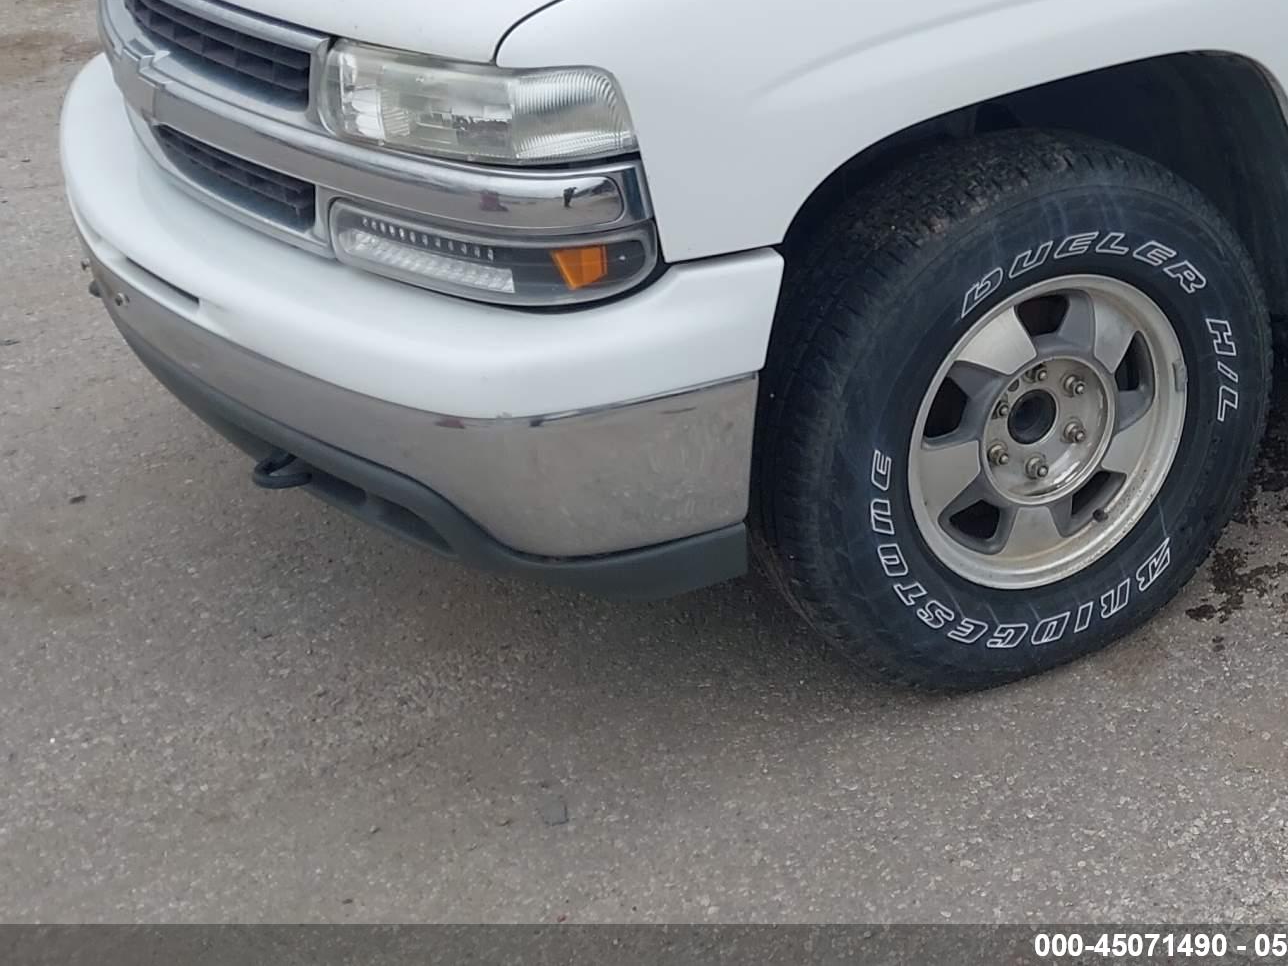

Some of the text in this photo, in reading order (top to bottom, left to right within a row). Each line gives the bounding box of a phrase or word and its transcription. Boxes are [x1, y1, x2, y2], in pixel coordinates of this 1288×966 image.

[961, 231, 1239, 422] DUELER H/L
[870, 449, 1171, 649] BRIDGESTONE
